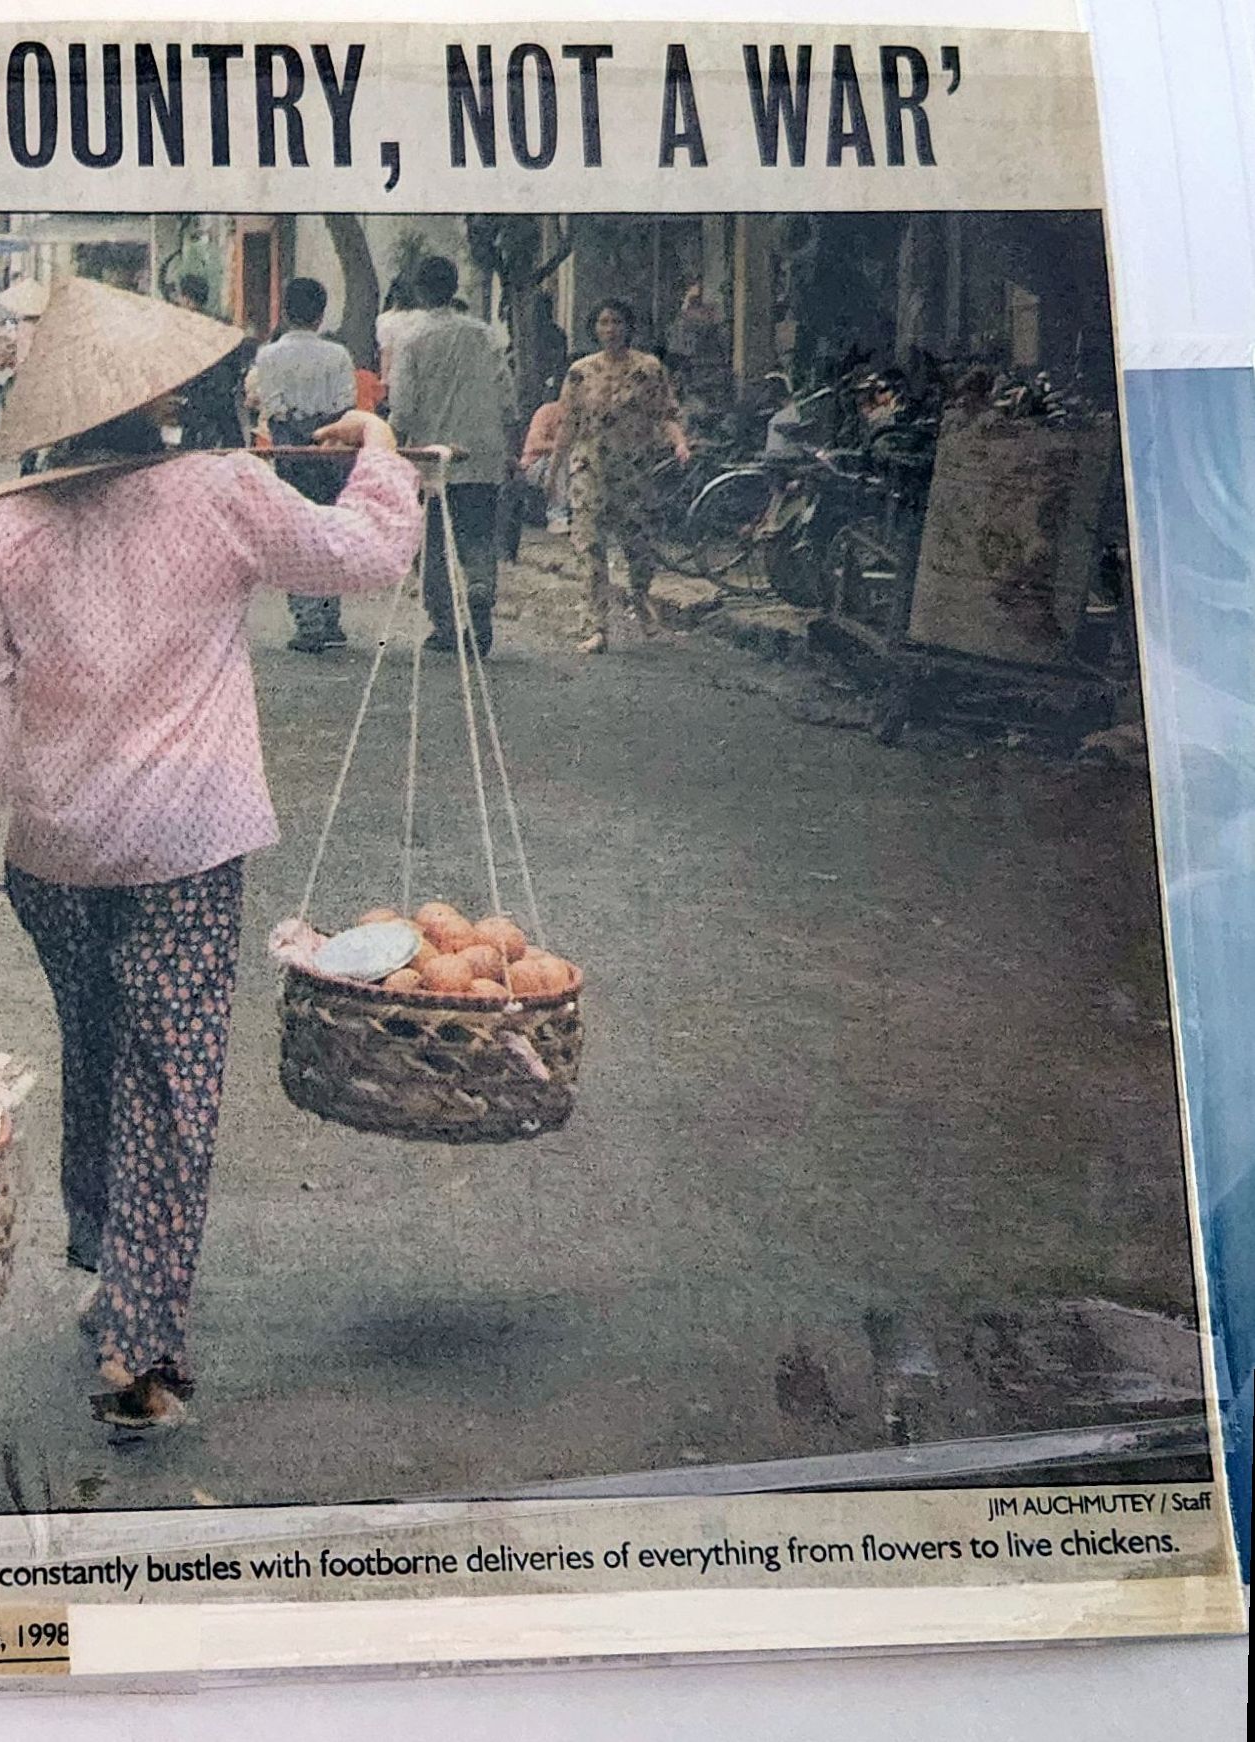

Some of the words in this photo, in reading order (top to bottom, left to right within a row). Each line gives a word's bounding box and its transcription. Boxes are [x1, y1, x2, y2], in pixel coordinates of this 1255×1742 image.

[446, 42, 614, 170] NOT
[658, 43, 709, 168] A
[988, 1497, 1018, 1521] JIM
[1023, 1493, 1156, 1515] AUCHMUTEY
[1160, 1492, 1167, 1515] /
[1171, 1491, 1212, 1512] Staff
[146, 1553, 242, 1583] bustles
[249, 1550, 311, 1579] with
[319, 1547, 458, 1577] footborne
[466, 1544, 595, 1573] deliveries
[603, 1541, 631, 1569] of
[638, 1539, 782, 1575] everything
[787, 1536, 854, 1564] from
[861, 1534, 963, 1561] flowers
[969, 1538, 999, 1559] to
[1006, 1530, 1053, 1558] live
[1060, 1527, 1180, 1557] chickens.
[18, 1622, 69, 1648] 1998
